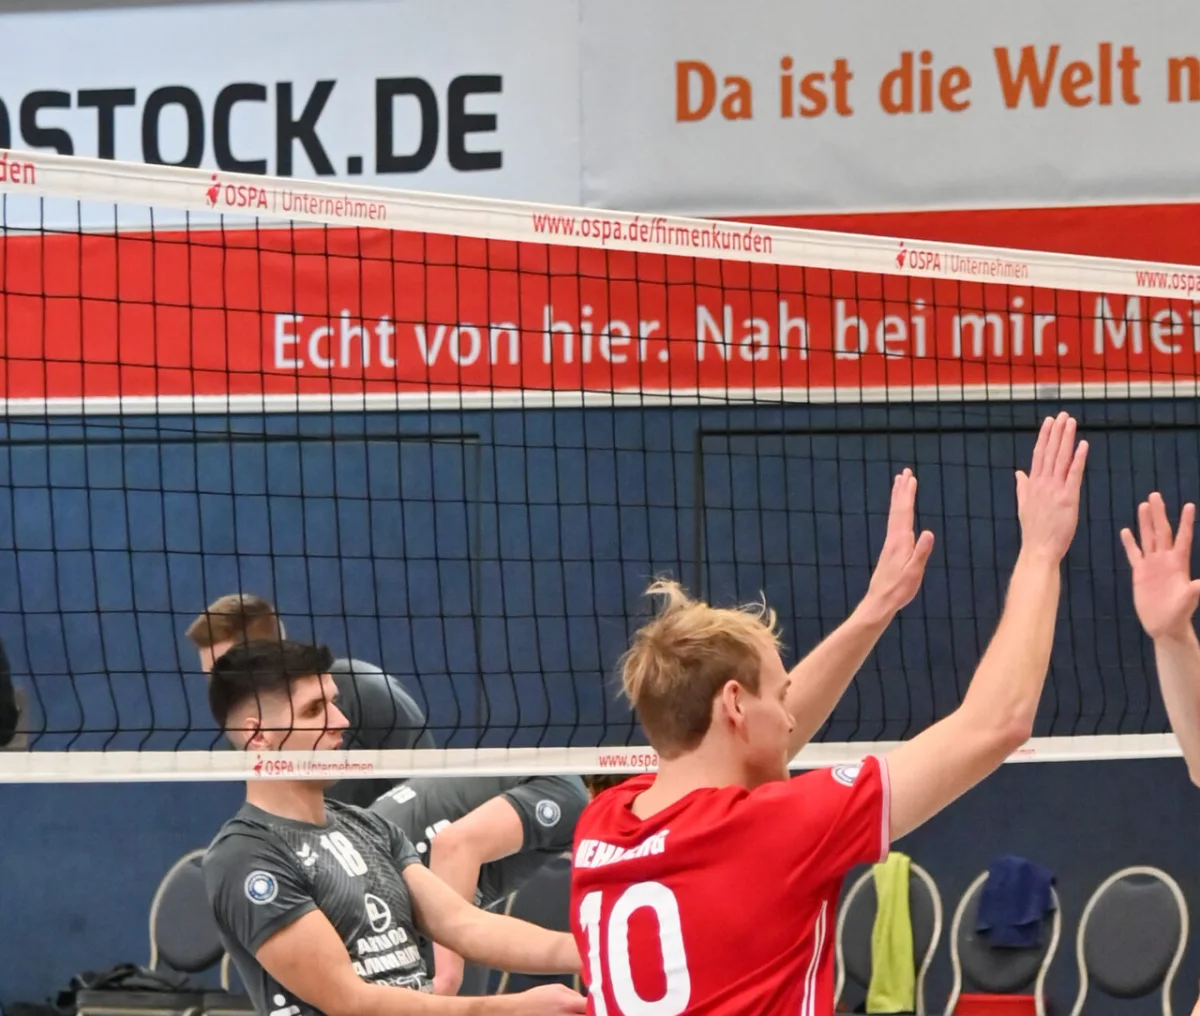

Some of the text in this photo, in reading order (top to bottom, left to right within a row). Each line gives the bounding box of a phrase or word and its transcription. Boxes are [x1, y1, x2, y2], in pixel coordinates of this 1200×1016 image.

[676, 59, 754, 124] Da
[780, 56, 854, 119] ist
[879, 50, 972, 115] die
[993, 42, 1140, 110] Welt
[0, 74, 504, 175] STOCK.DE
[224, 184, 387, 221] OSPA Unternehmen
[532, 212, 773, 254] www.ospa.de/firmenkunden
[909, 249, 1029, 280] OSPA Unternehmen
[274, 309, 397, 370] Echt
[416, 319, 518, 366] von
[543, 305, 669, 364] hier.
[697, 300, 809, 361] Nah
[835, 297, 927, 360] bei
[952, 297, 1068, 357] mir.
